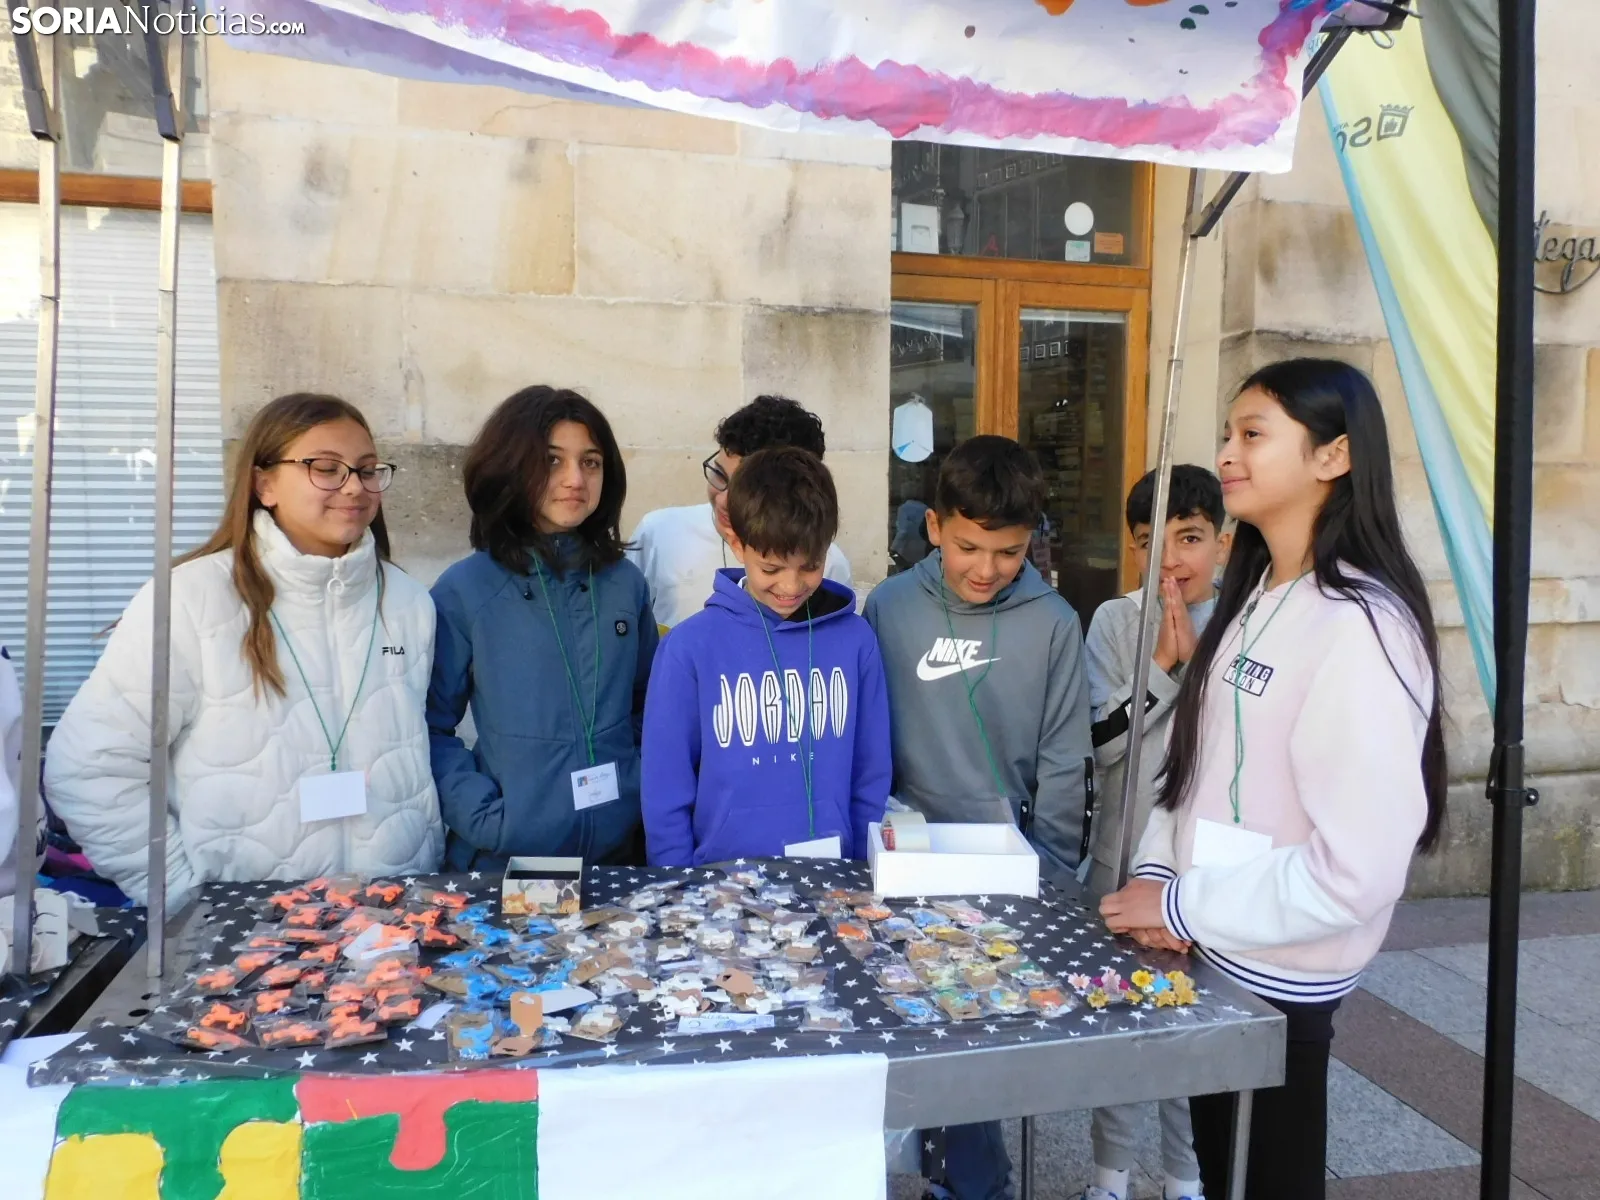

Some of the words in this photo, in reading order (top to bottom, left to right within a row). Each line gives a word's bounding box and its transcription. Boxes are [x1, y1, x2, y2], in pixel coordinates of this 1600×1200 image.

[382, 646, 405, 656] FILA
[928, 637, 982, 663] NIKE
[713, 666, 848, 748] JORDAN
[752, 752, 814, 765] NIKE
